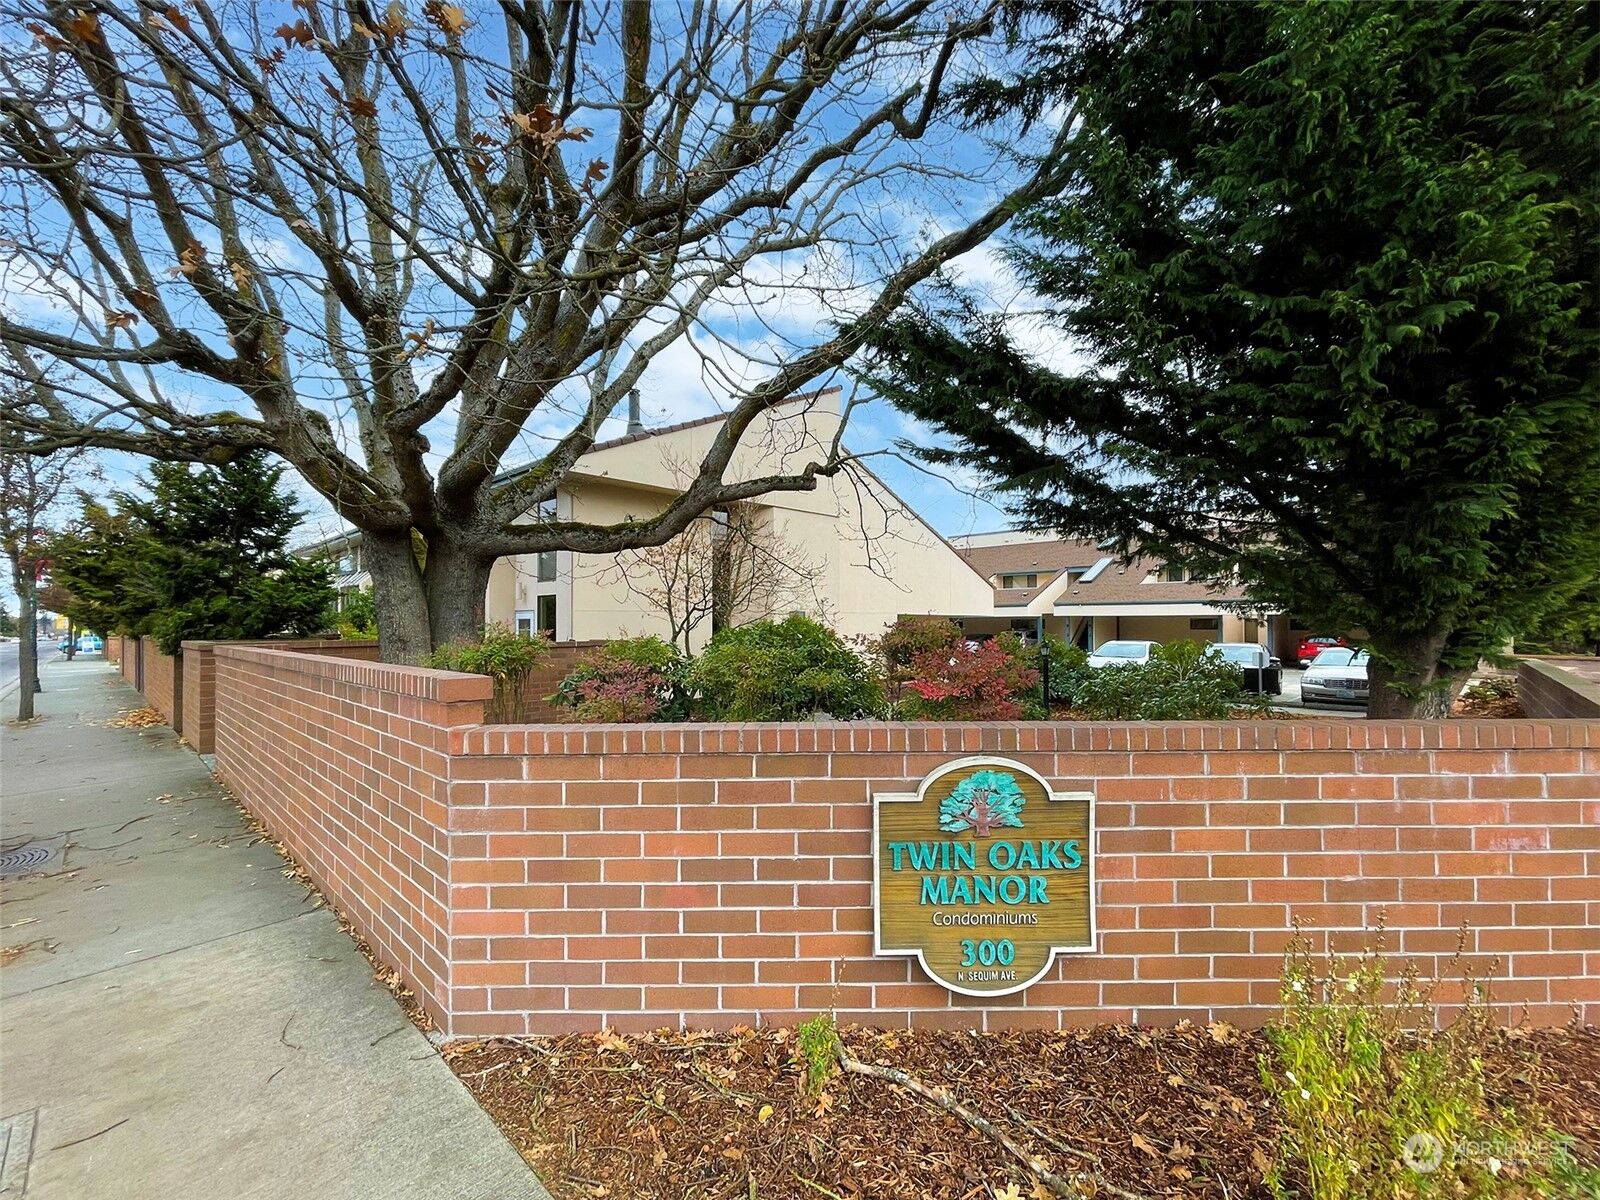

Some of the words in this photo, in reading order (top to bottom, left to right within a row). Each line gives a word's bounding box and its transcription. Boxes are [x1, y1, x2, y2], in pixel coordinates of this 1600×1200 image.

[888, 840, 976, 871] TWIN
[988, 840, 1082, 870] OAKS
[920, 875, 1050, 905] MANOR
[932, 911, 1038, 926] Condominiums
[960, 938, 1015, 967] 300
[957, 971, 964, 981] N
[968, 971, 999, 981] SEQUIM
[1000, 970, 1019, 981] AVE.
